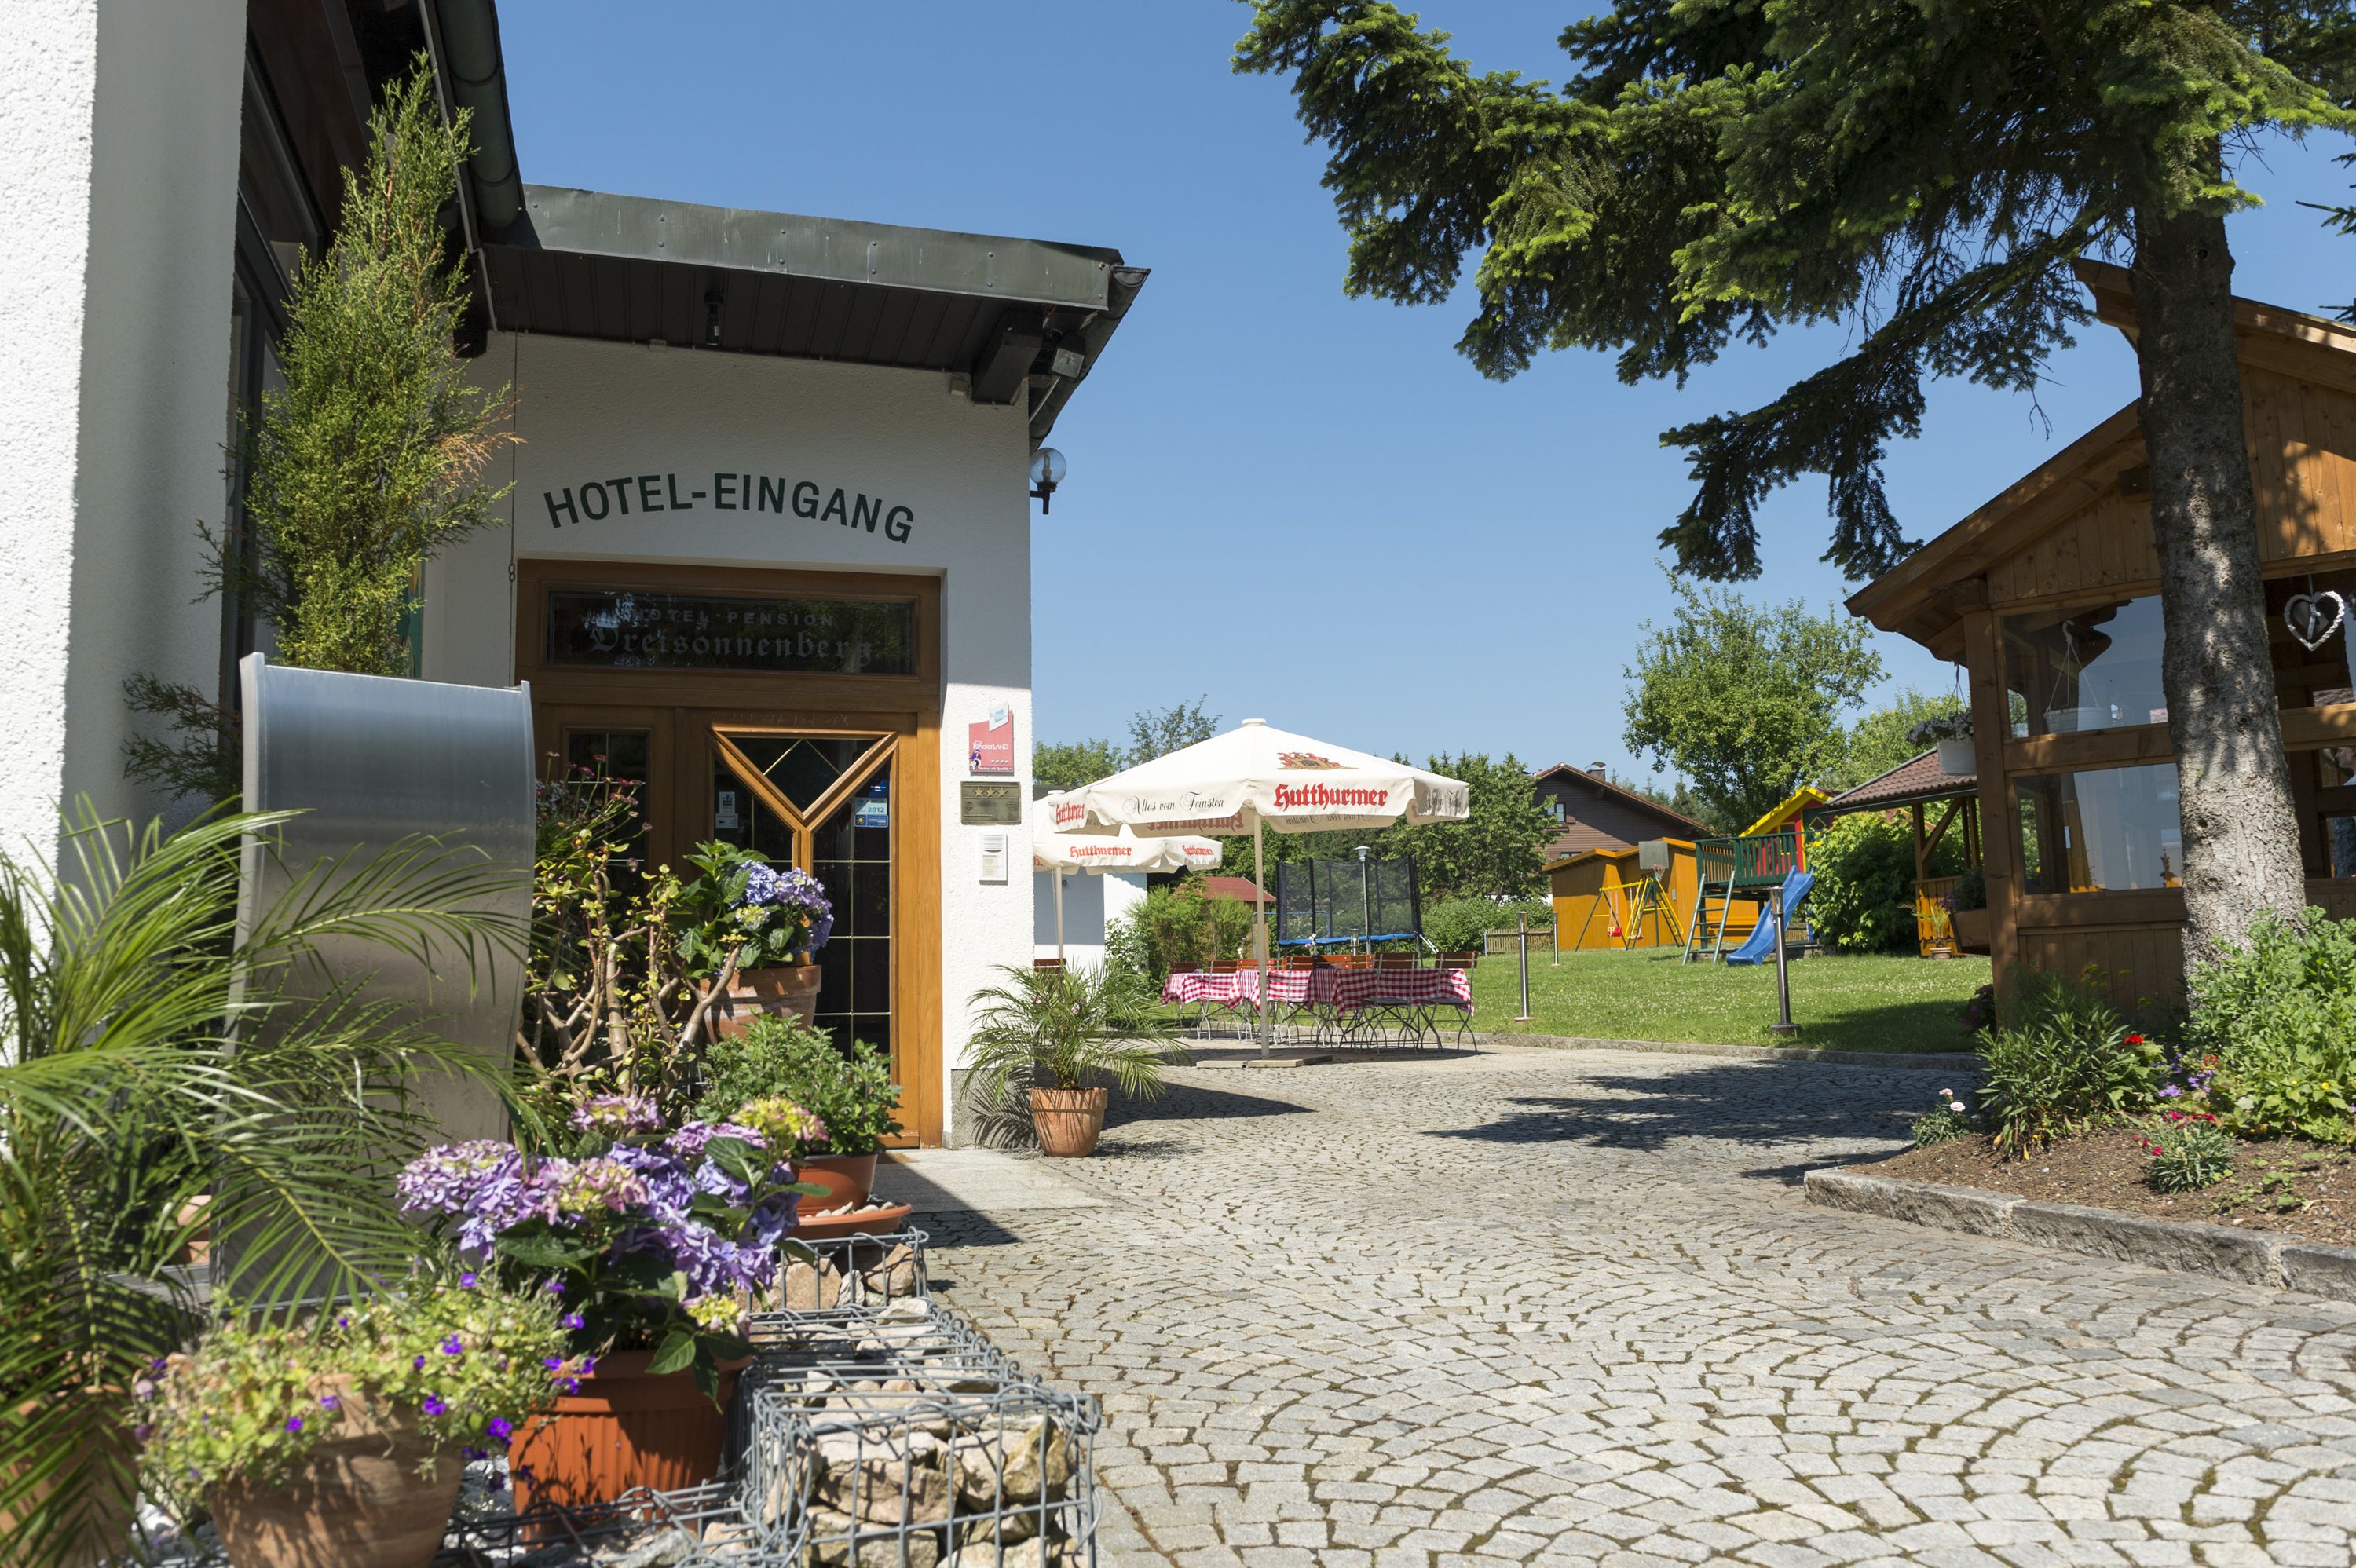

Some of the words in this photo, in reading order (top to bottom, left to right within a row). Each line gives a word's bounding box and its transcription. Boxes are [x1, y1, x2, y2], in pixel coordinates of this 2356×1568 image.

[544, 473, 914, 544] HOTEL-EINGANG
[1122, 795, 1157, 815] Alles
[1159, 802, 1176, 810] vom
[1274, 783, 1388, 812] Hutthurmer
[1070, 845, 1132, 860] Hutthurmer
